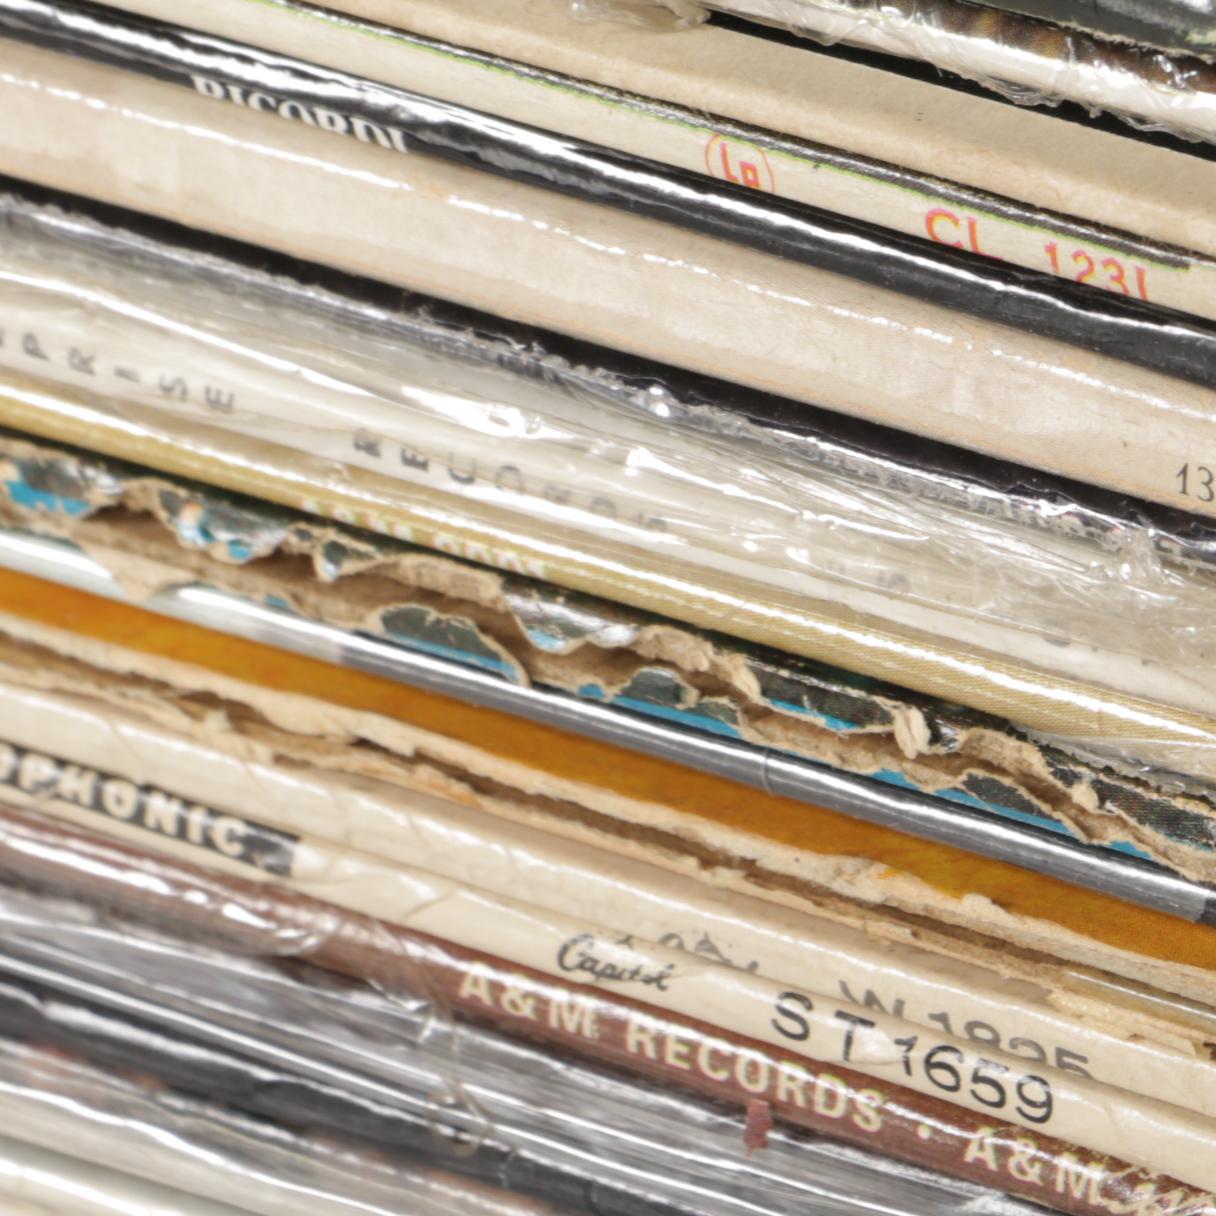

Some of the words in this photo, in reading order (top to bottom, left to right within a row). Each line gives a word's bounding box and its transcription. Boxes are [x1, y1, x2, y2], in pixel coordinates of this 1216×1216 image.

[0, 329, 236, 414] PRISE
[624, 1014, 886, 1134] RECORDS
[894, 1034, 1054, 1125] 1659
